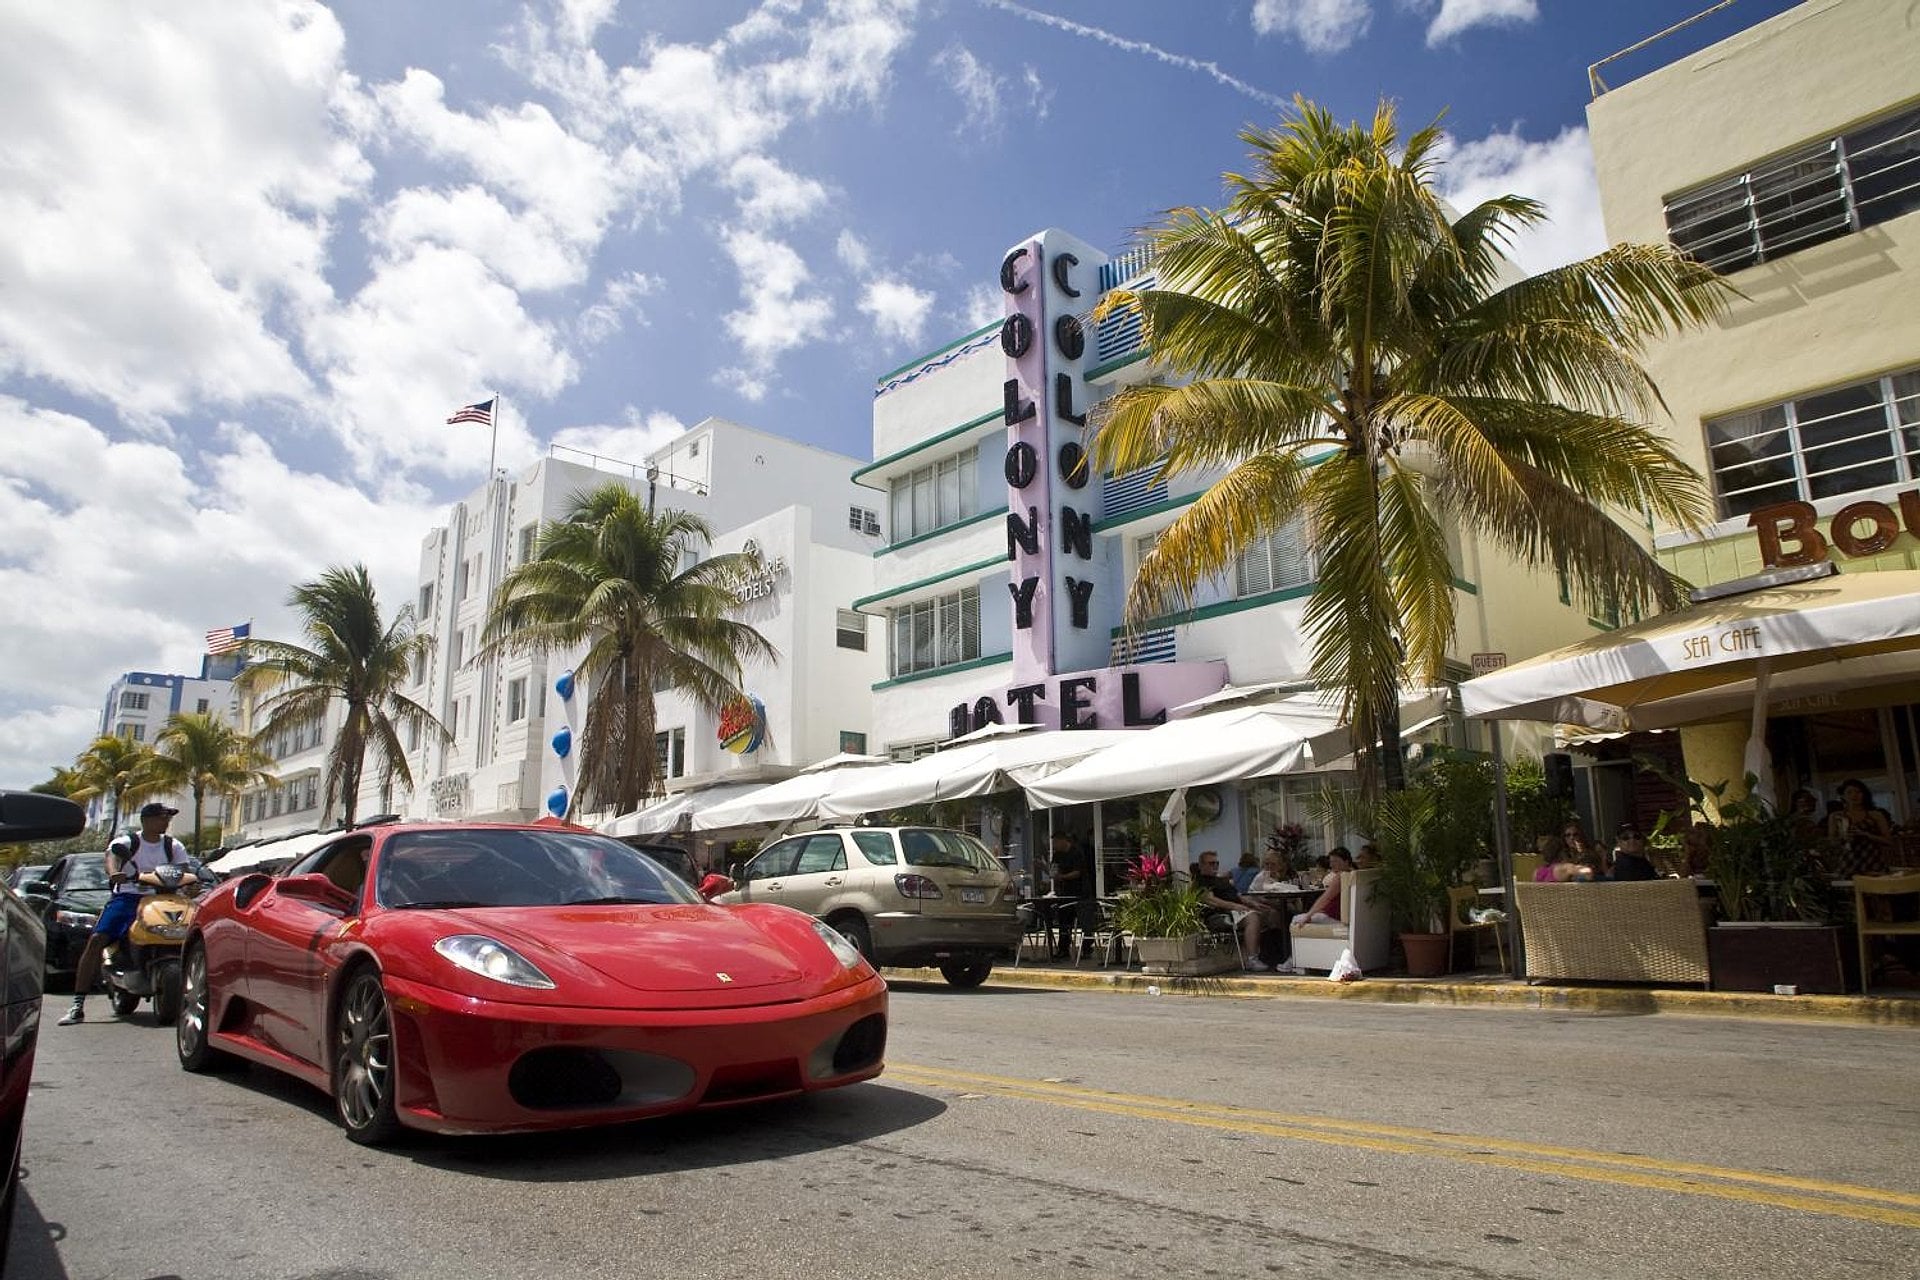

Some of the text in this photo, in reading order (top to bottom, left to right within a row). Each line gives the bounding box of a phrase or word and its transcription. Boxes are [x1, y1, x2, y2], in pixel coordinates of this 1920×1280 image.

[1001, 248, 1039, 629] COLONY
[1054, 253, 1094, 629] COLONY
[730, 579, 771, 604] ODELS
[1683, 626, 1763, 661] SEA CAFE
[949, 673, 1166, 739] HOTEL
